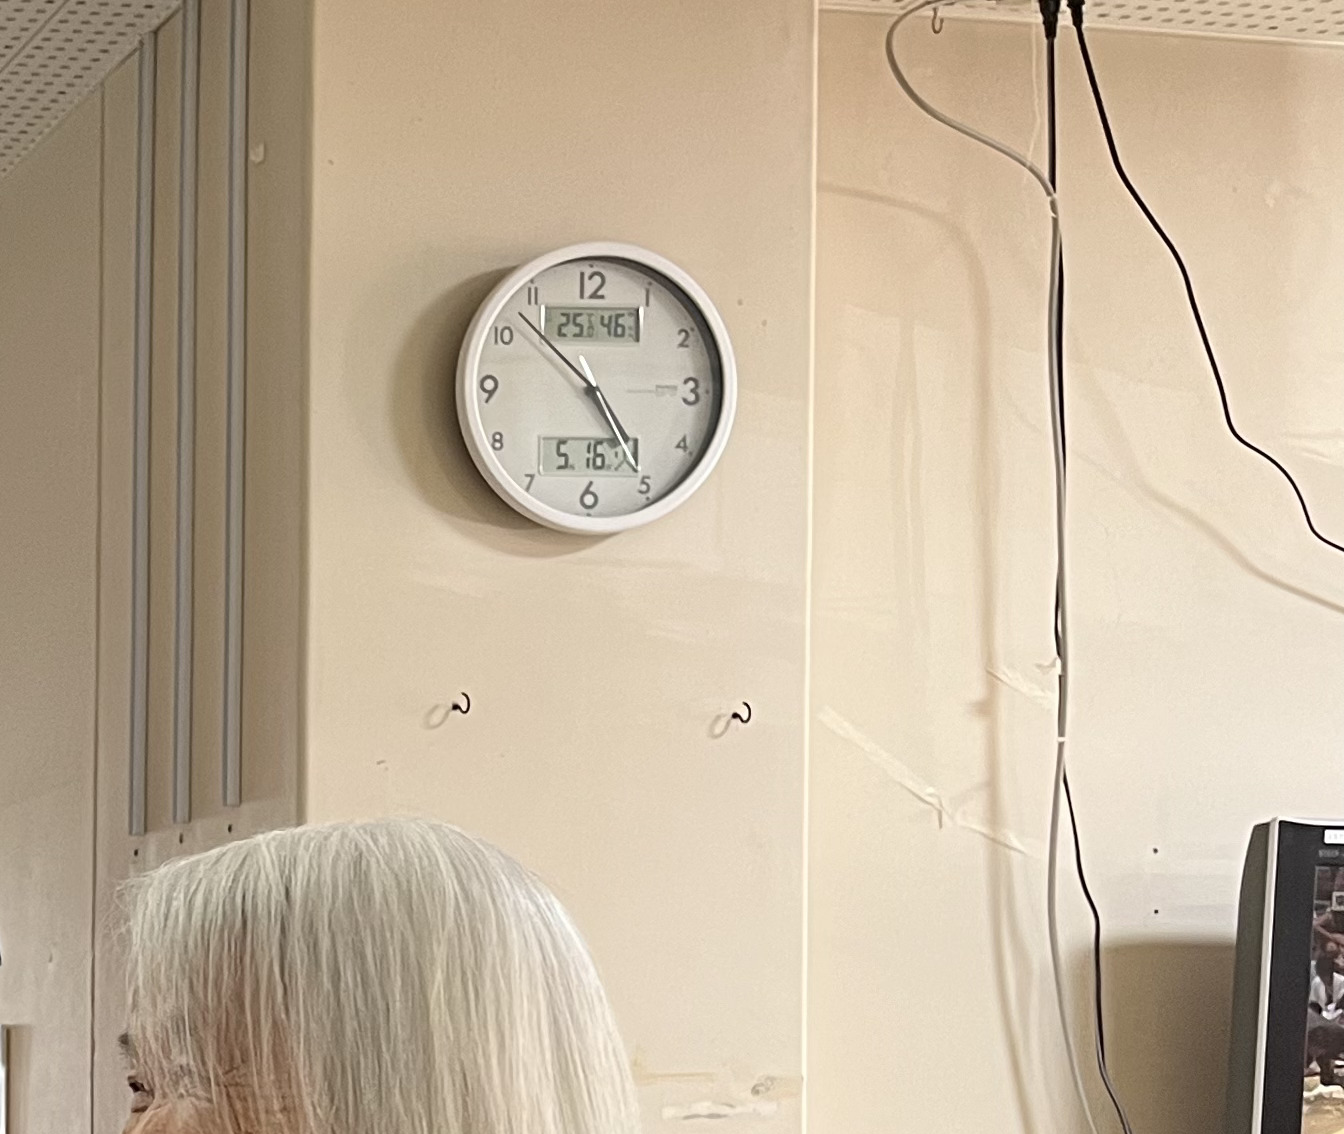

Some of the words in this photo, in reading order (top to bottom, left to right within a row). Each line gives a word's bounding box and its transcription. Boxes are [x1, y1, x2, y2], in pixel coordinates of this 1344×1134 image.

[579, 271, 606, 300] 12
[527, 286, 539, 306] 11
[643, 287, 651, 308] 1
[493, 326, 514, 346] 10
[677, 328, 691, 348] 2
[479, 374, 499, 403] 9
[681, 376, 700, 406] 3
[491, 431, 504, 451] 8
[675, 434, 689, 453] 4
[524, 473, 535, 494] 7
[638, 475, 651, 495] 5
[579, 480, 599, 510] 6
